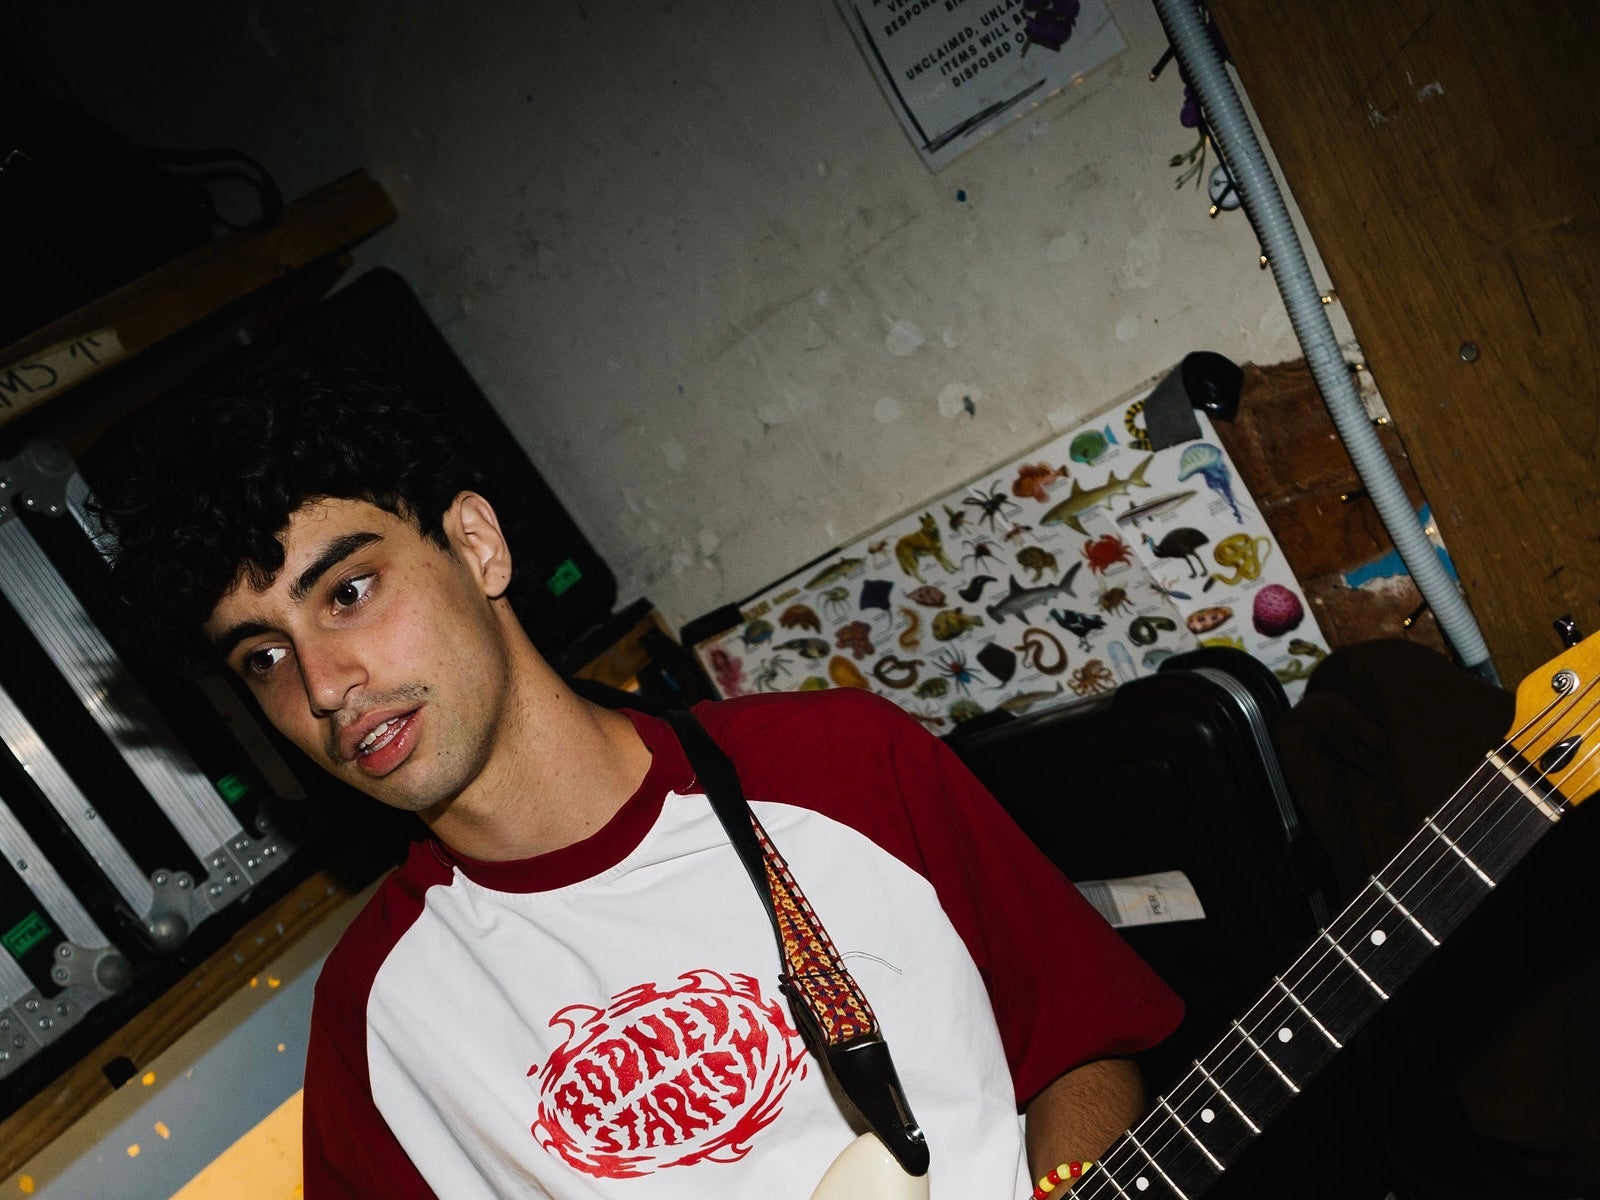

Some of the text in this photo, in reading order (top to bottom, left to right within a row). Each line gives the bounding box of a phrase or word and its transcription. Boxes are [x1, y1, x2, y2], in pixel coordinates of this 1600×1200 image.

[887, 0, 909, 12] VE
[905, 26, 980, 80] UNCLAIMED,
[940, 44, 978, 76] ITEMS
[979, 22, 1010, 48] WILL
[951, 42, 1012, 88] DISPOSED
[554, 996, 729, 1134] RODNEY
[590, 1004, 769, 1153] STARFISH
